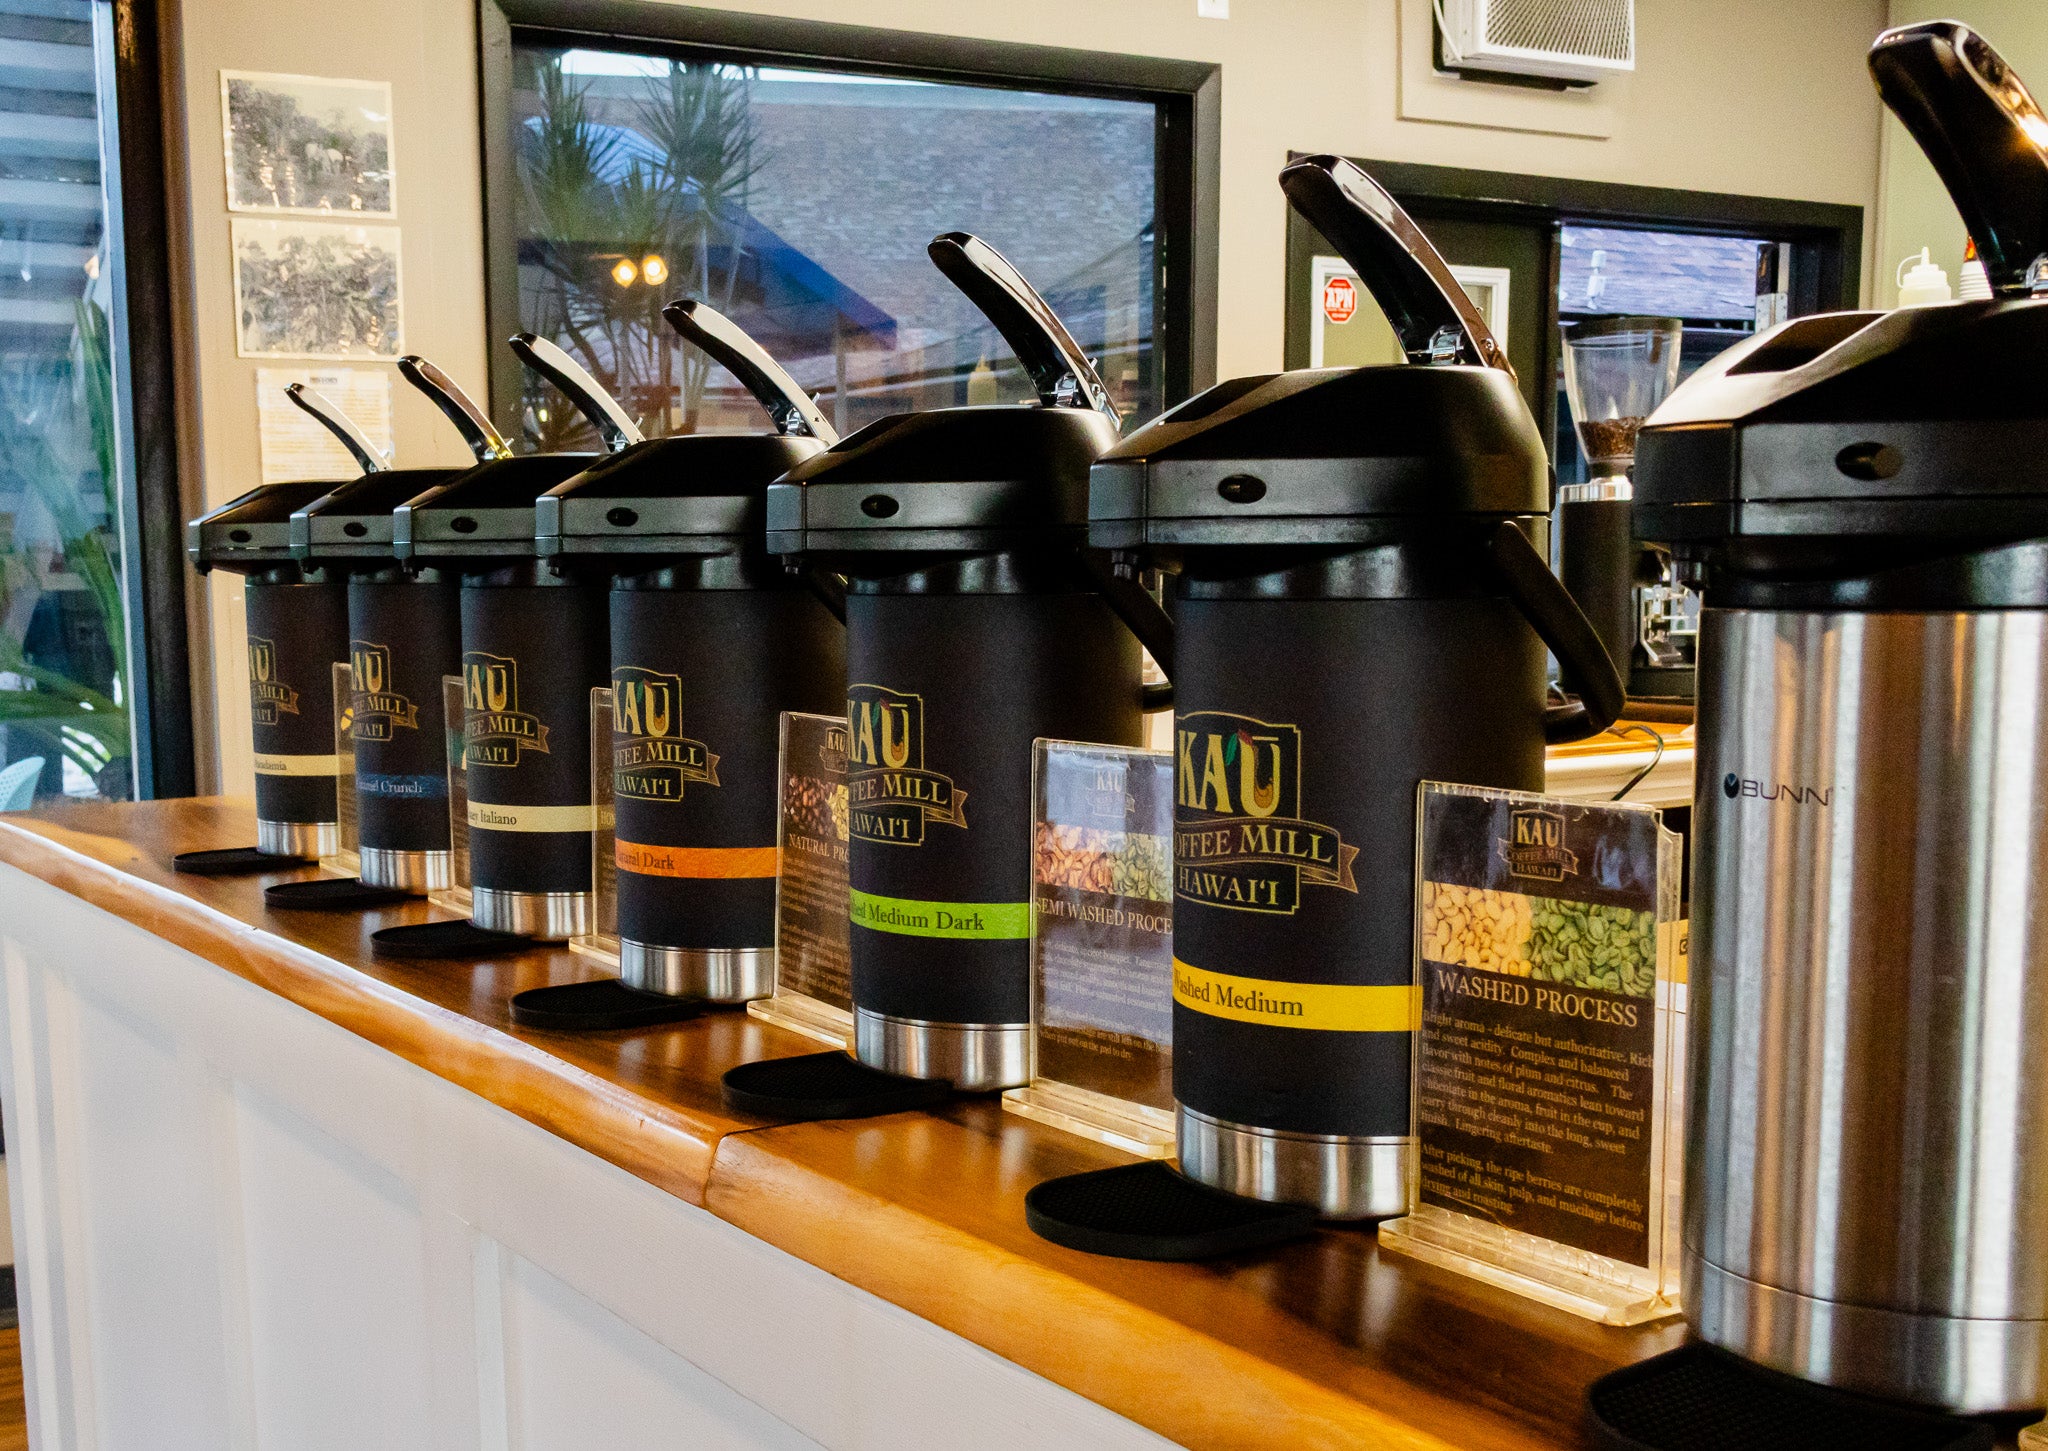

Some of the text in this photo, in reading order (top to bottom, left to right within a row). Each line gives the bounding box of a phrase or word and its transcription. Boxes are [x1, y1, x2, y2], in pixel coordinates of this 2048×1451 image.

[1326, 288, 1354, 309] APN
[368, 696, 406, 715] MILL
[488, 715, 535, 737] MILL
[646, 742, 704, 767] MILL
[380, 780, 423, 793] Crunch
[881, 773, 948, 804] MILL
[1741, 779, 1830, 807] BUNN
[480, 809, 518, 826] Italiano
[789, 833, 829, 857] NATURAL
[1174, 824, 1334, 863] OFFEE MILL
[642, 852, 675, 870] Dark
[869, 903, 929, 928] Medium
[936, 911, 985, 931] Dark
[1036, 898, 1172, 934] SEMI WASHED PROCE
[1215, 983, 1304, 1017] Medium
[1437, 970, 1638, 1027] WASHED PROCESS
[1454, 1019, 1485, 1033] aroma
[1494, 1023, 1533, 1044] delicate
[1535, 1031, 1551, 1047] but
[1442, 1034, 1468, 1047] sweet
[1511, 1045, 1556, 1066] Complex
[1558, 1058, 1578, 1071] and
[1581, 1060, 1629, 1081] balanced
[1451, 1050, 1472, 1065] with
[1474, 1056, 1501, 1072] notes
[1503, 1061, 1515, 1074] of
[1516, 1064, 1542, 1080] plum
[1545, 1072, 1563, 1086] and
[1610, 1084, 1633, 1100] The
[1477, 1074, 1496, 1088] and
[1498, 1077, 1525, 1094] floral
[1579, 1096, 1603, 1112] lean
[1605, 1103, 1644, 1122] toward
[1447, 1099, 1487, 1120] through
[1487, 1109, 1523, 1131] cleanly
[1524, 1118, 1546, 1134] into
[1547, 1124, 1564, 1139] the
[1469, 1087, 1479, 1100] in
[1480, 1090, 1497, 1105] the
[1535, 1103, 1557, 1120] fruit
[1560, 1107, 1571, 1123] in
[1573, 1112, 1592, 1127] the
[1618, 1126, 1640, 1140] and
[1455, 1118, 1502, 1144] Lingering
[1457, 1169, 1468, 1182] of
[1469, 1172, 1482, 1186] all
[1537, 1194, 1557, 1208] and
[1559, 1199, 1608, 1224] mucilage
[1609, 1210, 1645, 1233] before
[1486, 1161, 1503, 1175] the
[1526, 1170, 1562, 1191] berries
[1563, 1184, 1582, 1197] are
[1583, 1191, 1643, 1216] completely
